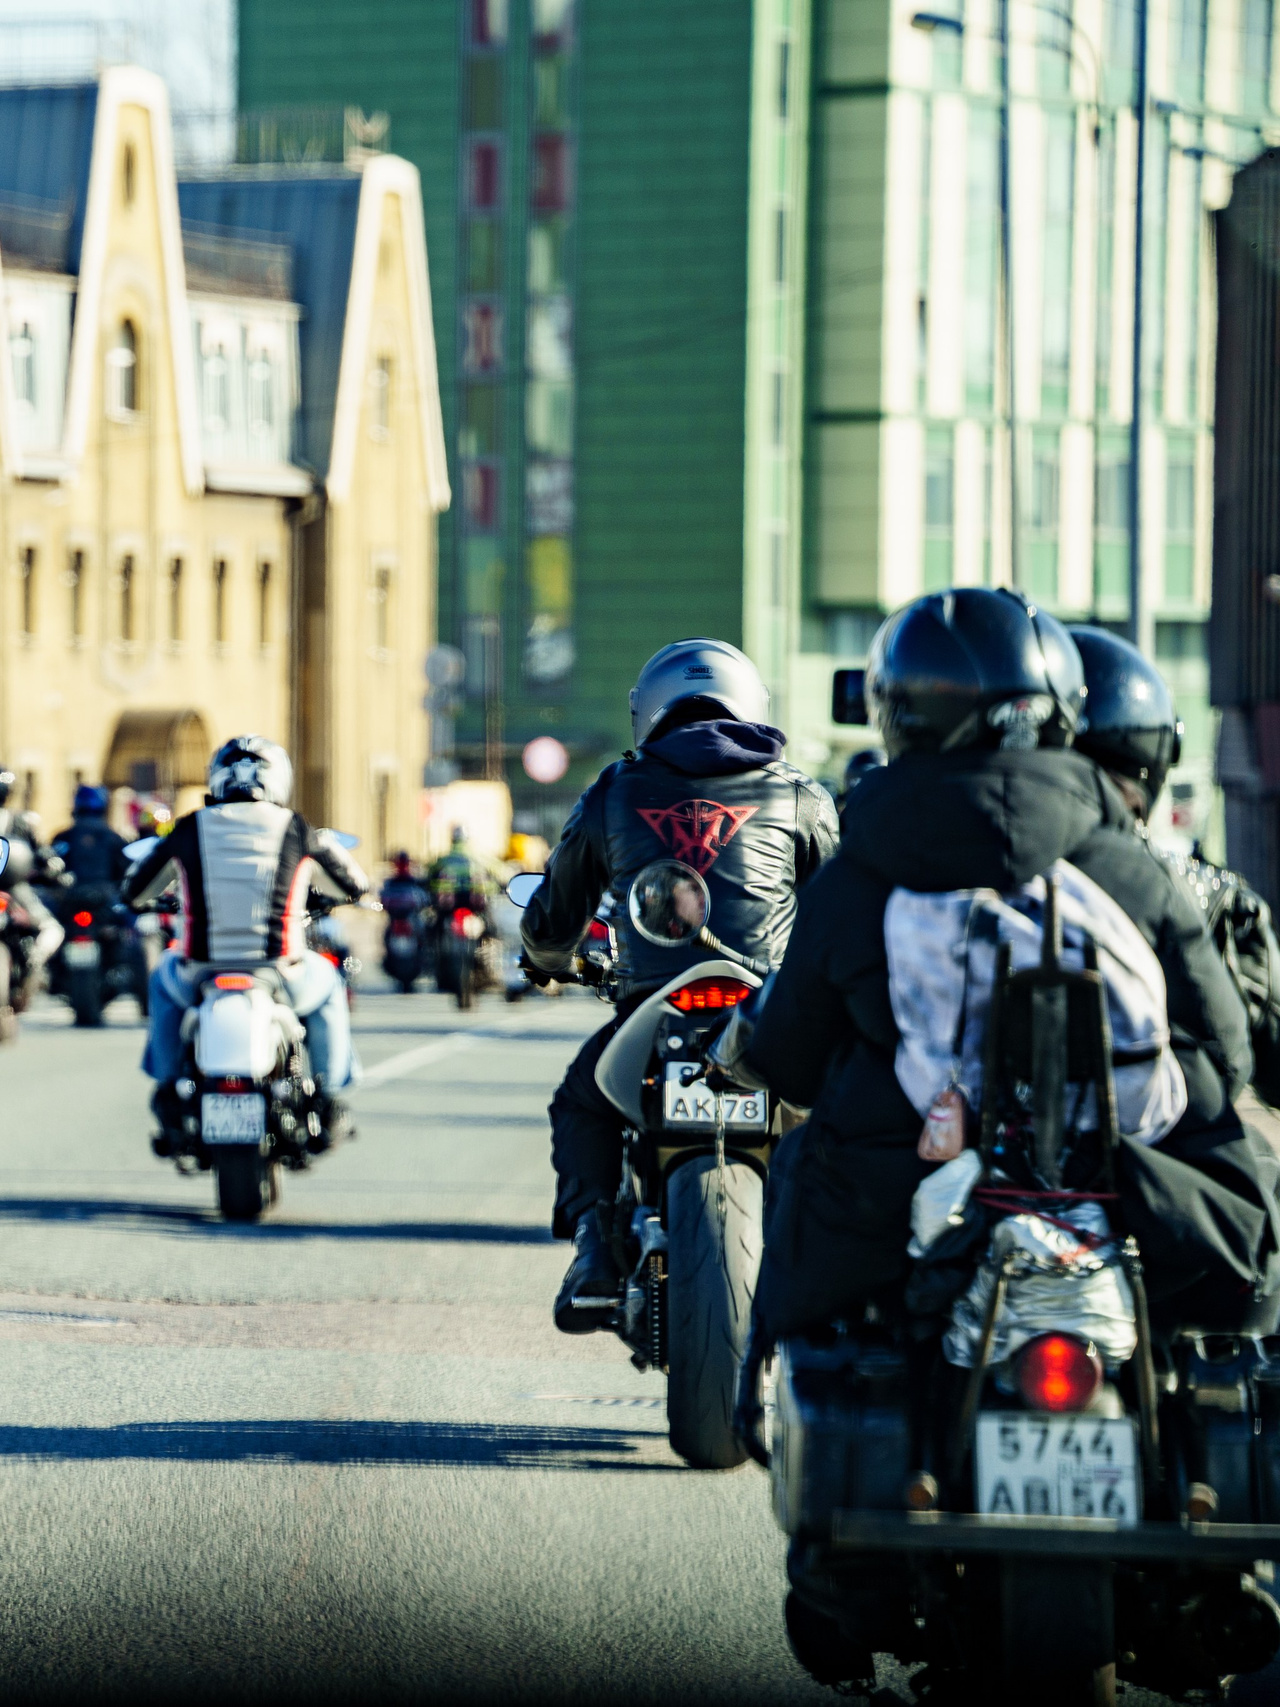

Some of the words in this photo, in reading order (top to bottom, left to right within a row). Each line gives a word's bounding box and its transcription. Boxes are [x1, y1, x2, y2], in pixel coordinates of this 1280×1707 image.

[673, 1098, 711, 1118] AK
[725, 1099, 759, 1119] 78
[999, 1415, 1114, 1464] 5744
[1072, 1476, 1127, 1518] 56
